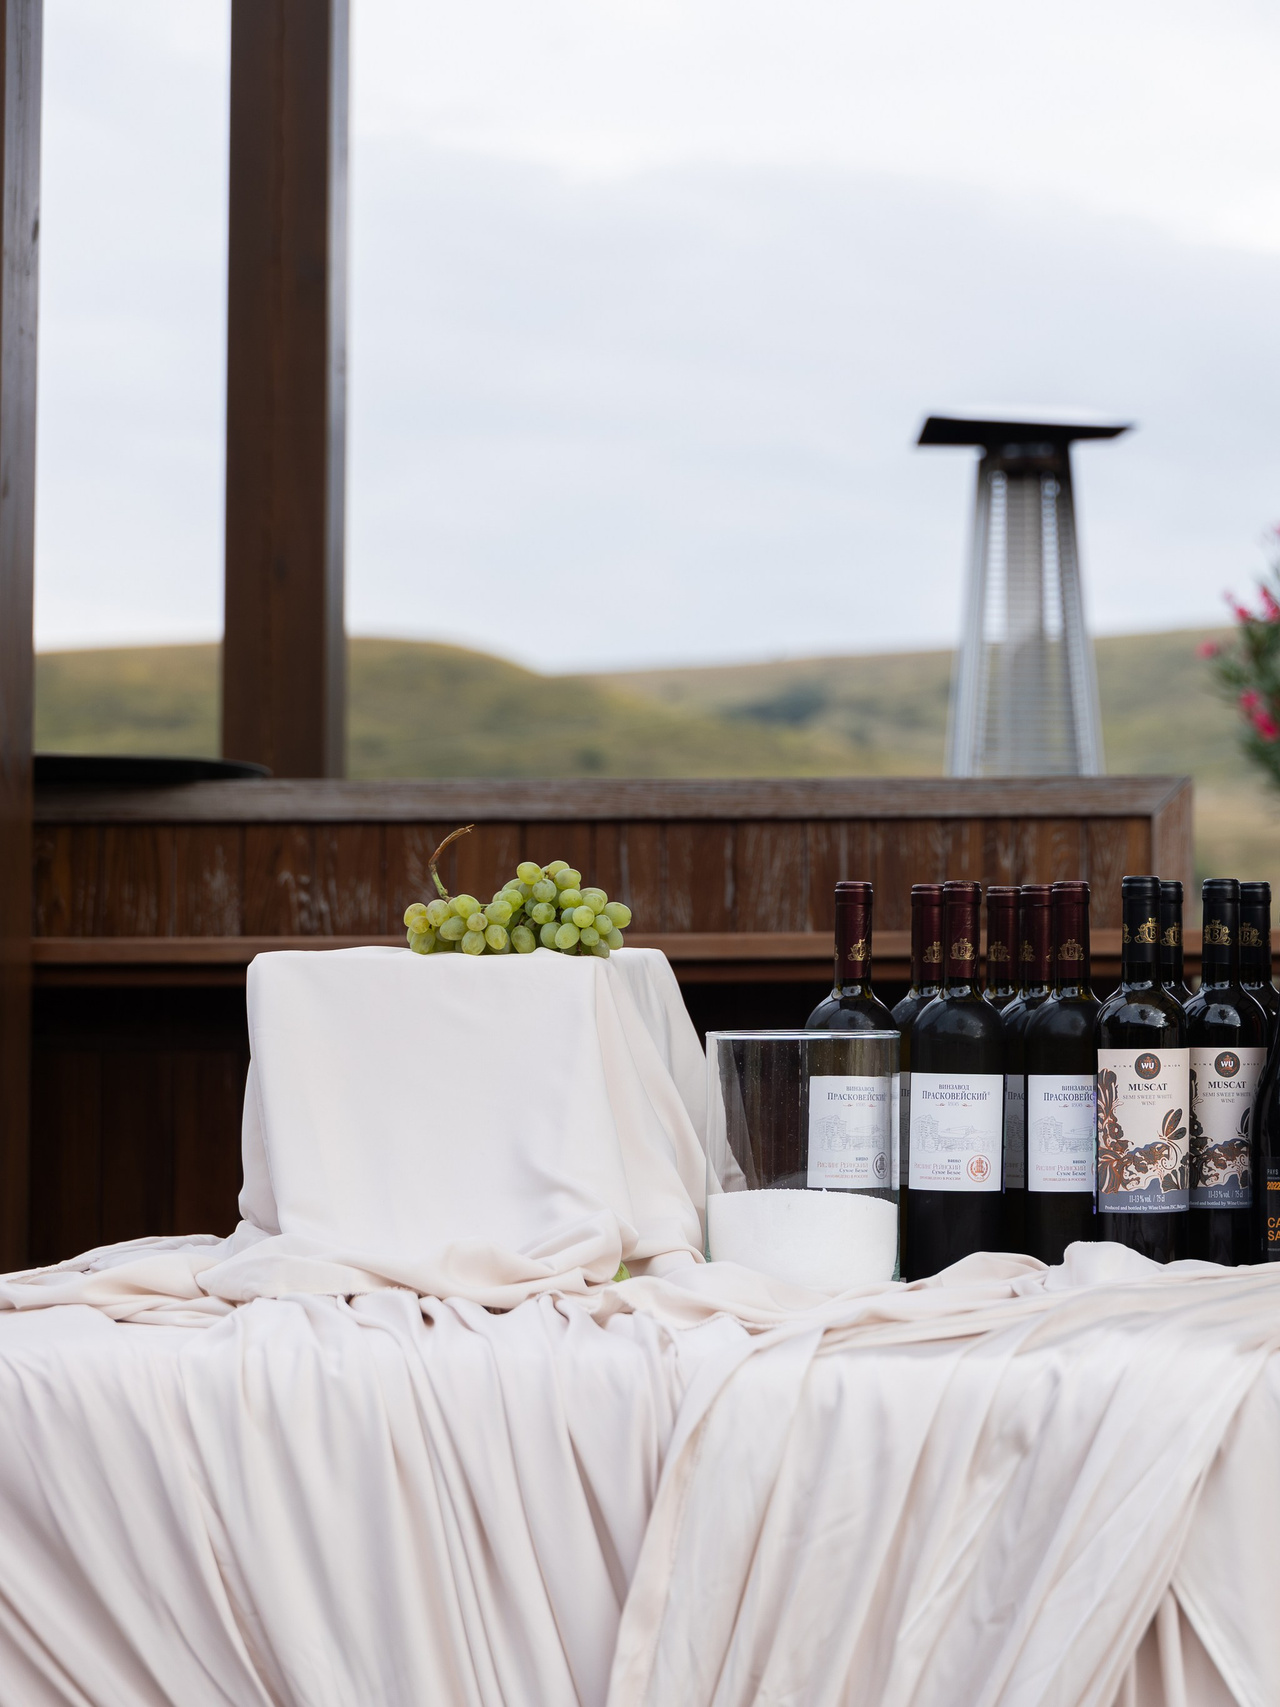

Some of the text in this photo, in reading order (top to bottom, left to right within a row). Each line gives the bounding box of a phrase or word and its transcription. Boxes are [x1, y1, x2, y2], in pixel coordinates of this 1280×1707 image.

[1128, 1083, 1167, 1091] MUSCAT
[1208, 1081, 1247, 1089] MUSCAT
[922, 1090, 987, 1100] ПРАСКОВЕЙСКИЙ
[1043, 1091, 1094, 1101] ПРАСКОВЕЙС
[1267, 1181, 1280, 1190] 2022
